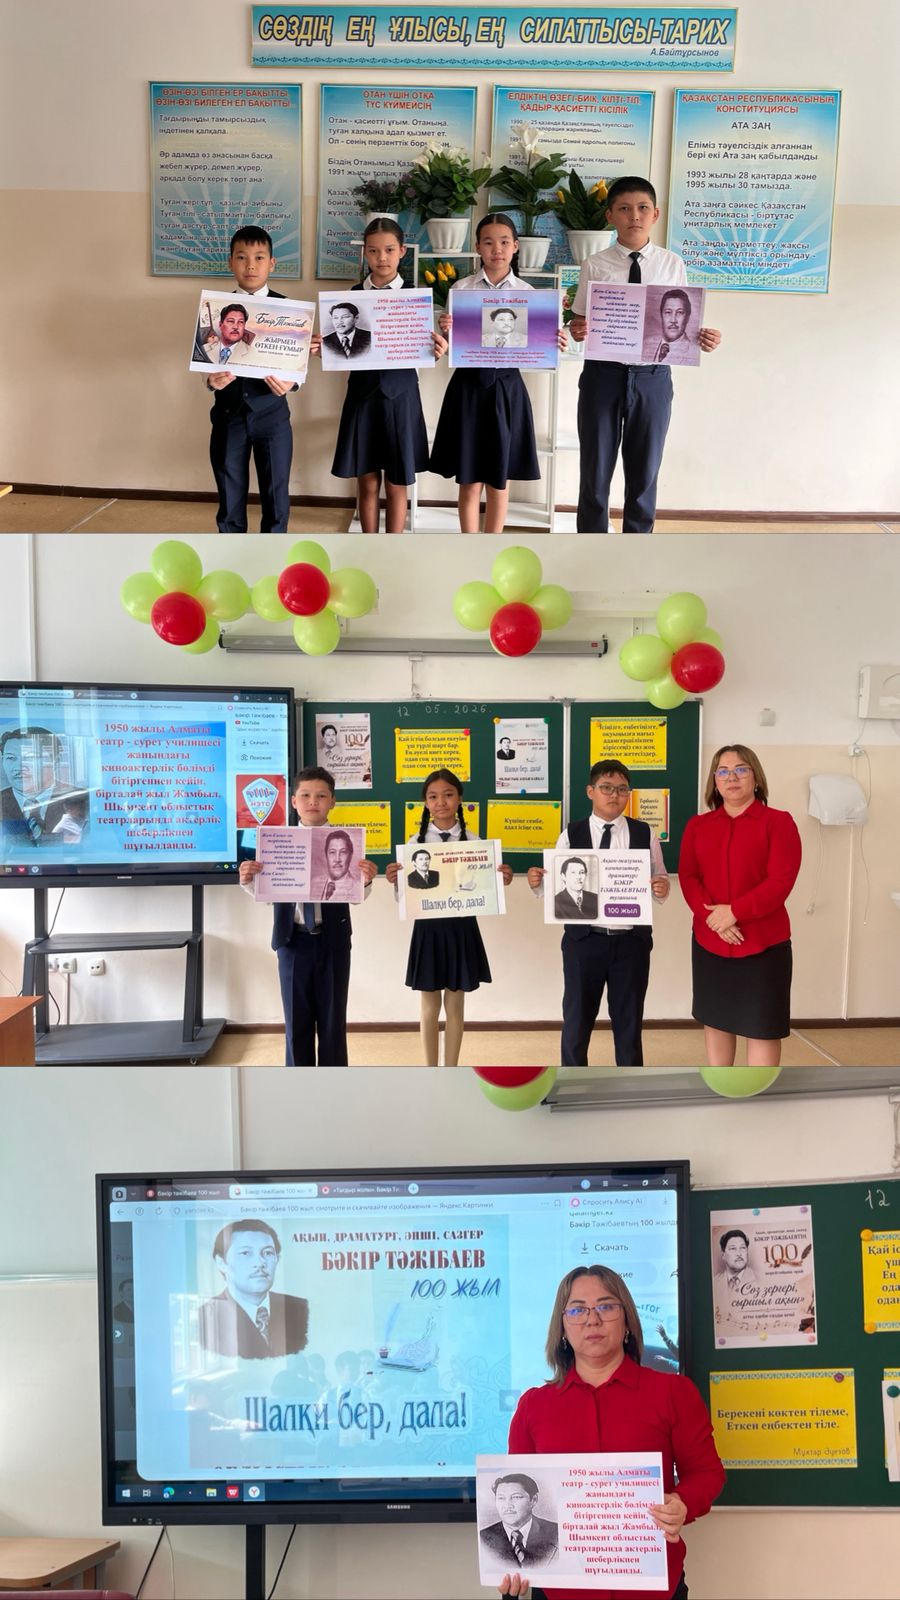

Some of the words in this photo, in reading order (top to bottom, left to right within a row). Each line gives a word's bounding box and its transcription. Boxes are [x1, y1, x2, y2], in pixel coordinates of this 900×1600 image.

[259, 15, 335, 47] СӨЗДІҢ
[346, 16, 376, 47] ЕҢ
[476, 17, 506, 48] ЕҢ
[682, 94, 734, 102] ҚАЗАҚСТАН
[716, 106, 798, 114] КОНСТИТУЦИЯСЫ
[328, 116, 347, 124] Отан
[752, 122, 771, 130] ЗАҢ
[688, 141, 716, 149] Еліміз
[687, 151, 706, 160] бері
[684, 200, 700, 208] Ата
[105, 724, 128, 732] 1950
[866, 1190, 890, 1209] 12
[443, 1230, 484, 1240] САЗГЕР
[594, 1244, 628, 1252] Скачать
[763, 1244, 798, 1263] 100
[322, 1252, 380, 1271] БӘКІР
[385, 1249, 486, 1270] ТӘЖІБАЕВ
[882, 1271, 896, 1279] Ең
[411, 1278, 446, 1298] 100
[450, 1278, 501, 1298] ЖЫЛ
[244, 1396, 329, 1438] Шалқи
[338, 1391, 390, 1440] бер,
[400, 1392, 467, 1436] дала!
[718, 1408, 765, 1420] Берекені
[727, 1422, 759, 1430] Еткен
